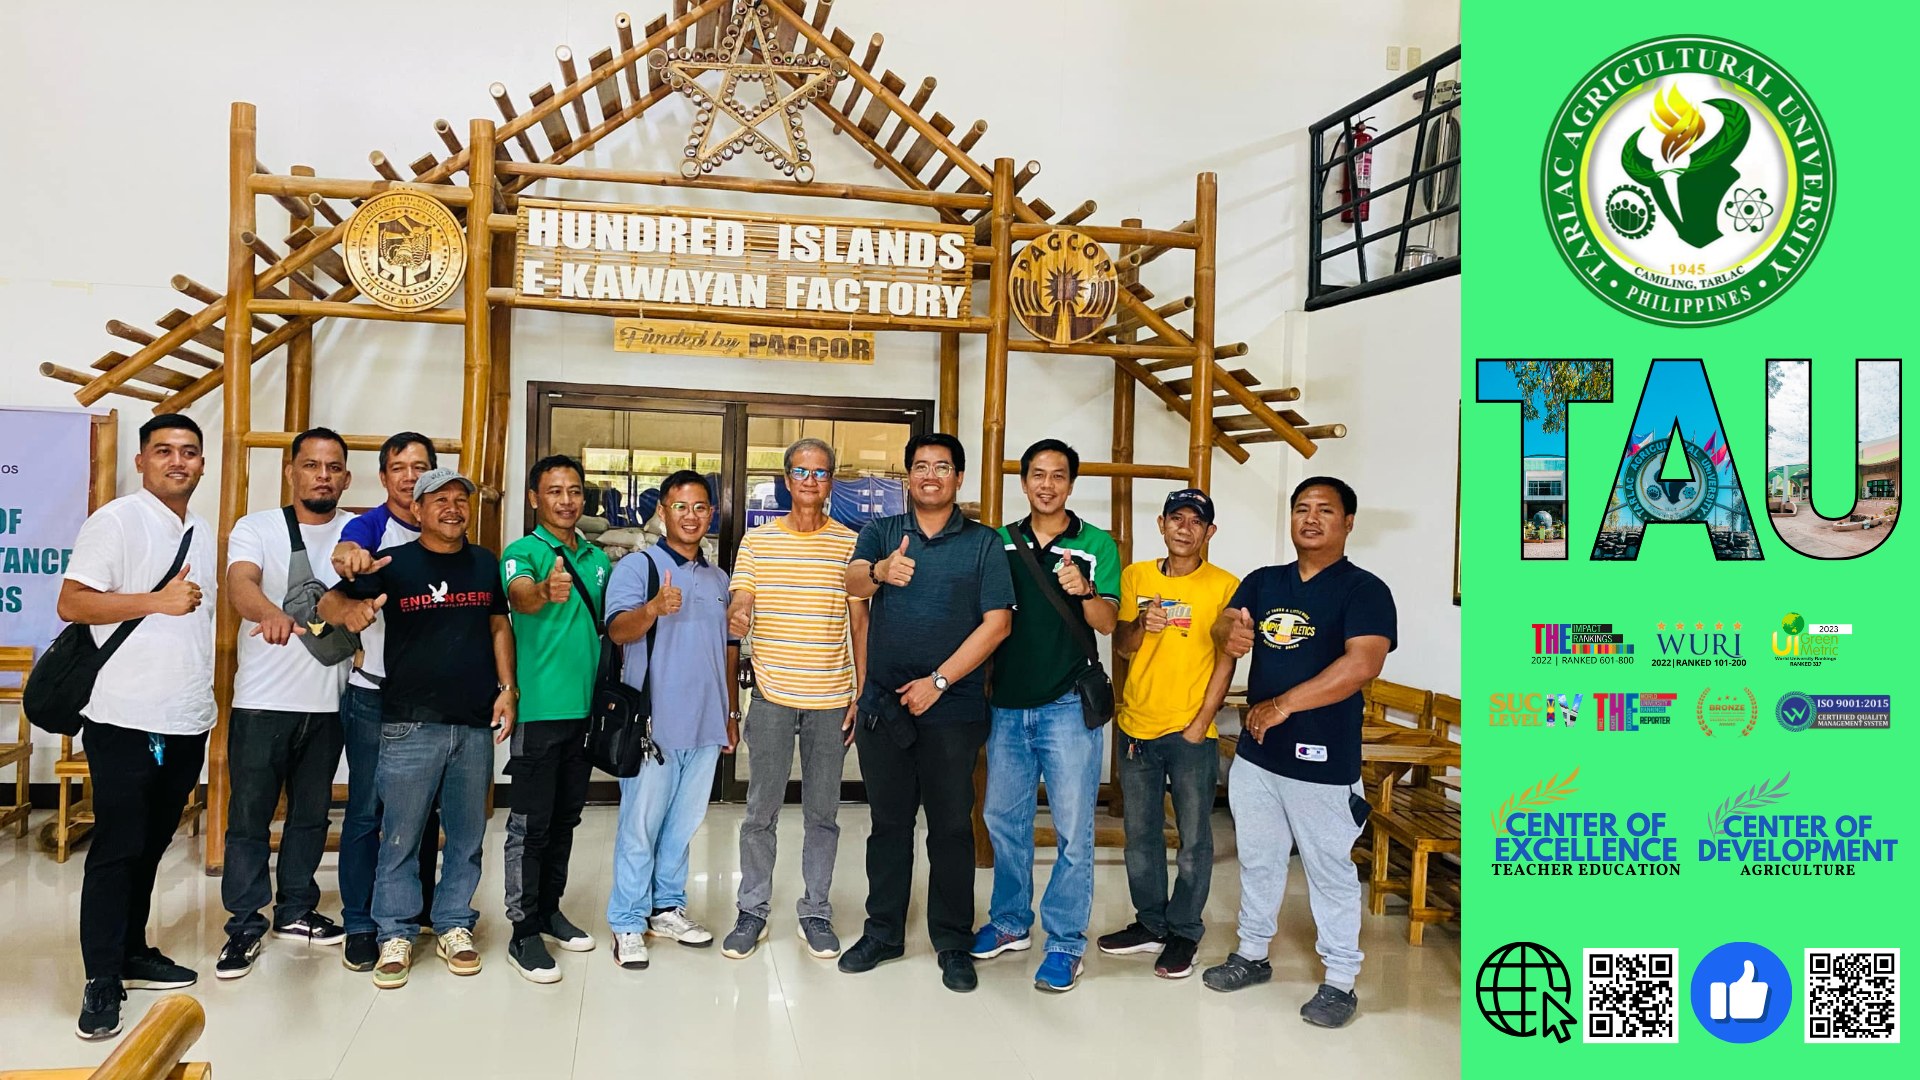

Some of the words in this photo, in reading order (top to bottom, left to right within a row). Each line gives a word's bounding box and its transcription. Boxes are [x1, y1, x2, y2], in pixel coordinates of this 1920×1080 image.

[528, 208, 745, 257] HUNDRED
[777, 222, 966, 271] ISLANDS
[1018, 233, 1111, 278] PAGCOR
[360, 276, 382, 297] CITY
[382, 294, 397, 304] OF
[398, 281, 448, 305] ALAMINOS
[522, 259, 768, 309] E-KAWAYAN
[785, 275, 966, 319] FACTORY
[620, 324, 707, 350] Funded
[706, 331, 740, 355] by
[748, 333, 870, 361] PAGCOR
